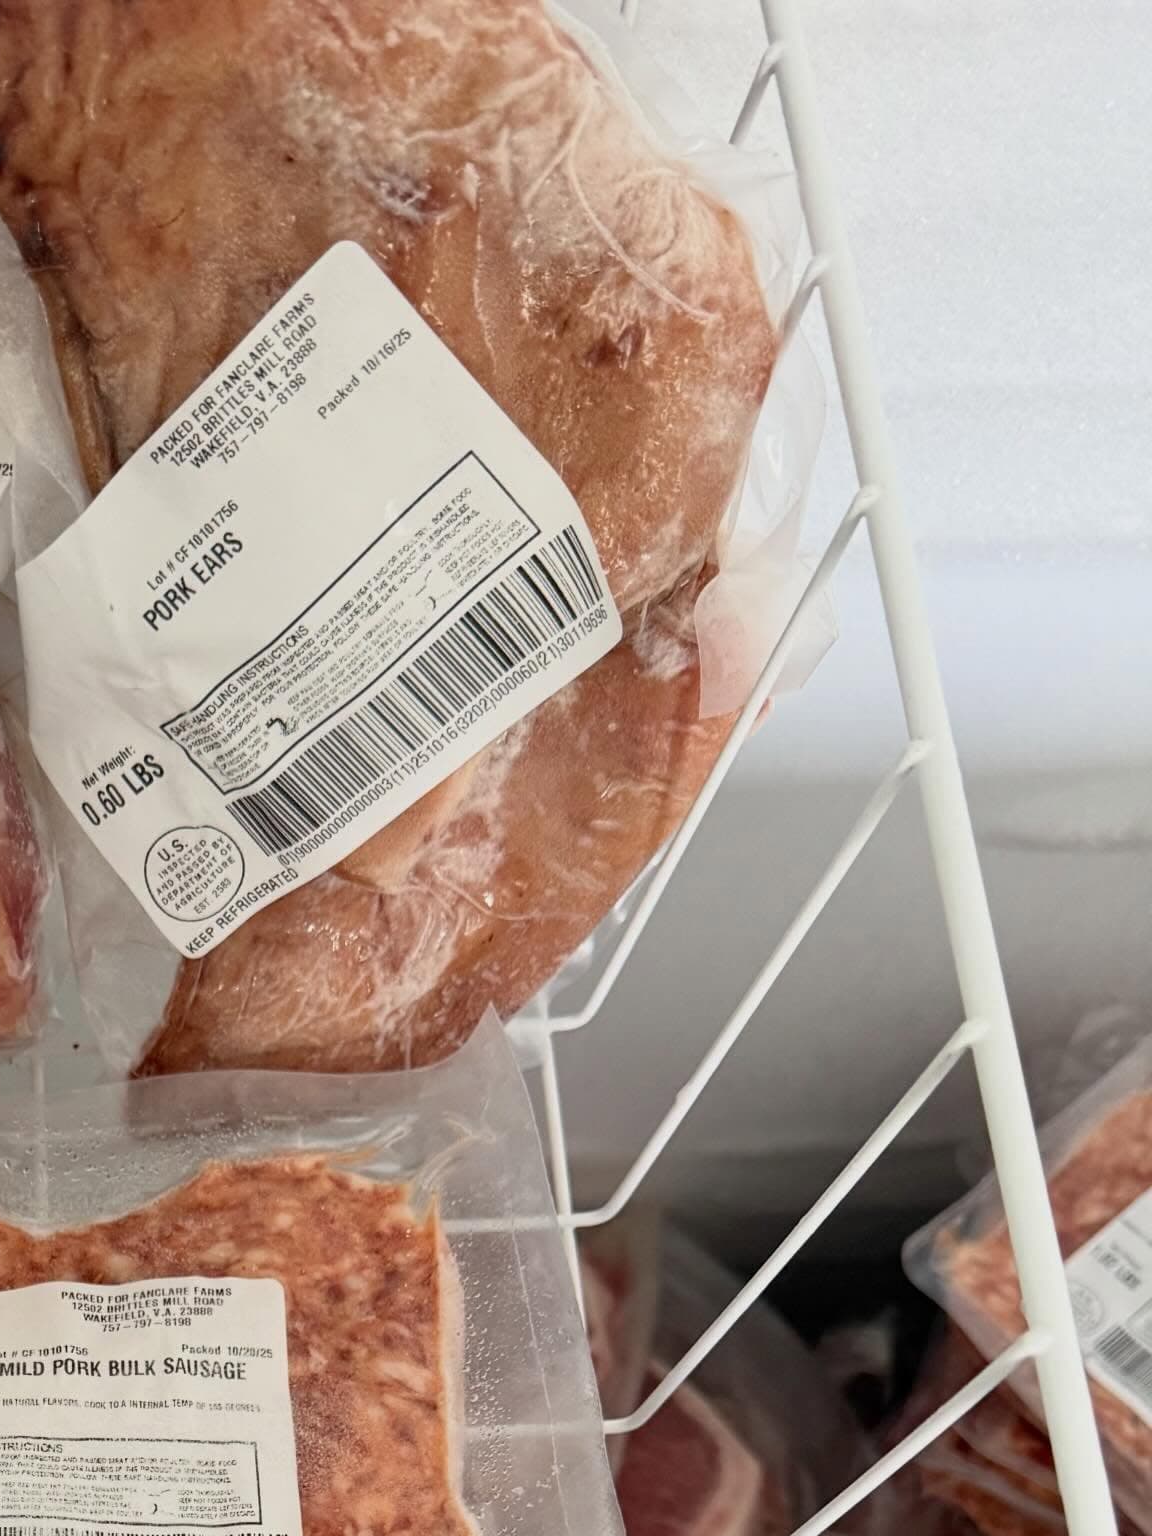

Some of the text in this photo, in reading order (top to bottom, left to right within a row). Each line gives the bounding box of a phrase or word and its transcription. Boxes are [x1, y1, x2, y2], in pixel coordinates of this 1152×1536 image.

[150, 292, 316, 464] PACKED FOR FANCLARE FARMS
[170, 314, 317, 468] 12502 BRITTLES MILL ROAD
[317, 328, 412, 420] Packed 10/16/25
[189, 338, 317, 470] WAKEFIELD, V.A. 23888
[146, 499, 239, 591] Lot CF10101756
[142, 532, 243, 631] PORK EARS
[238, 625, 309, 686] INSTRUCTIONS
[82, 773, 99, 790] Net
[82, 783, 126, 826] 0.60
[122, 754, 164, 795] LBS
[156, 837, 225, 896] AND BY
[157, 839, 188, 862] U.S.
[157, 839, 207, 879] INSPECTED
[161, 844, 233, 906] DEPARTMENT OF
[175, 857, 236, 911] AGRICULTURE
[186, 868, 299, 954] KEEP REFRIGERATED
[61, 1286, 232, 1304] PACKED FOR FANCLARE FARMS
[72, 1297, 224, 1312] 12502 BRITTLES MILL ROAD
[83, 1307, 213, 1322] WAKEFIELD, V.A. 23888
[0, 1361, 45, 1377] MILD
[53, 1359, 101, 1377] PORK
[109, 1360, 156, 1377] BULK
[164, 1358, 247, 1380] SAUSAGE
[182, 1344, 221, 1355] Packed
[129, 1400, 169, 1409] INTERNAL
